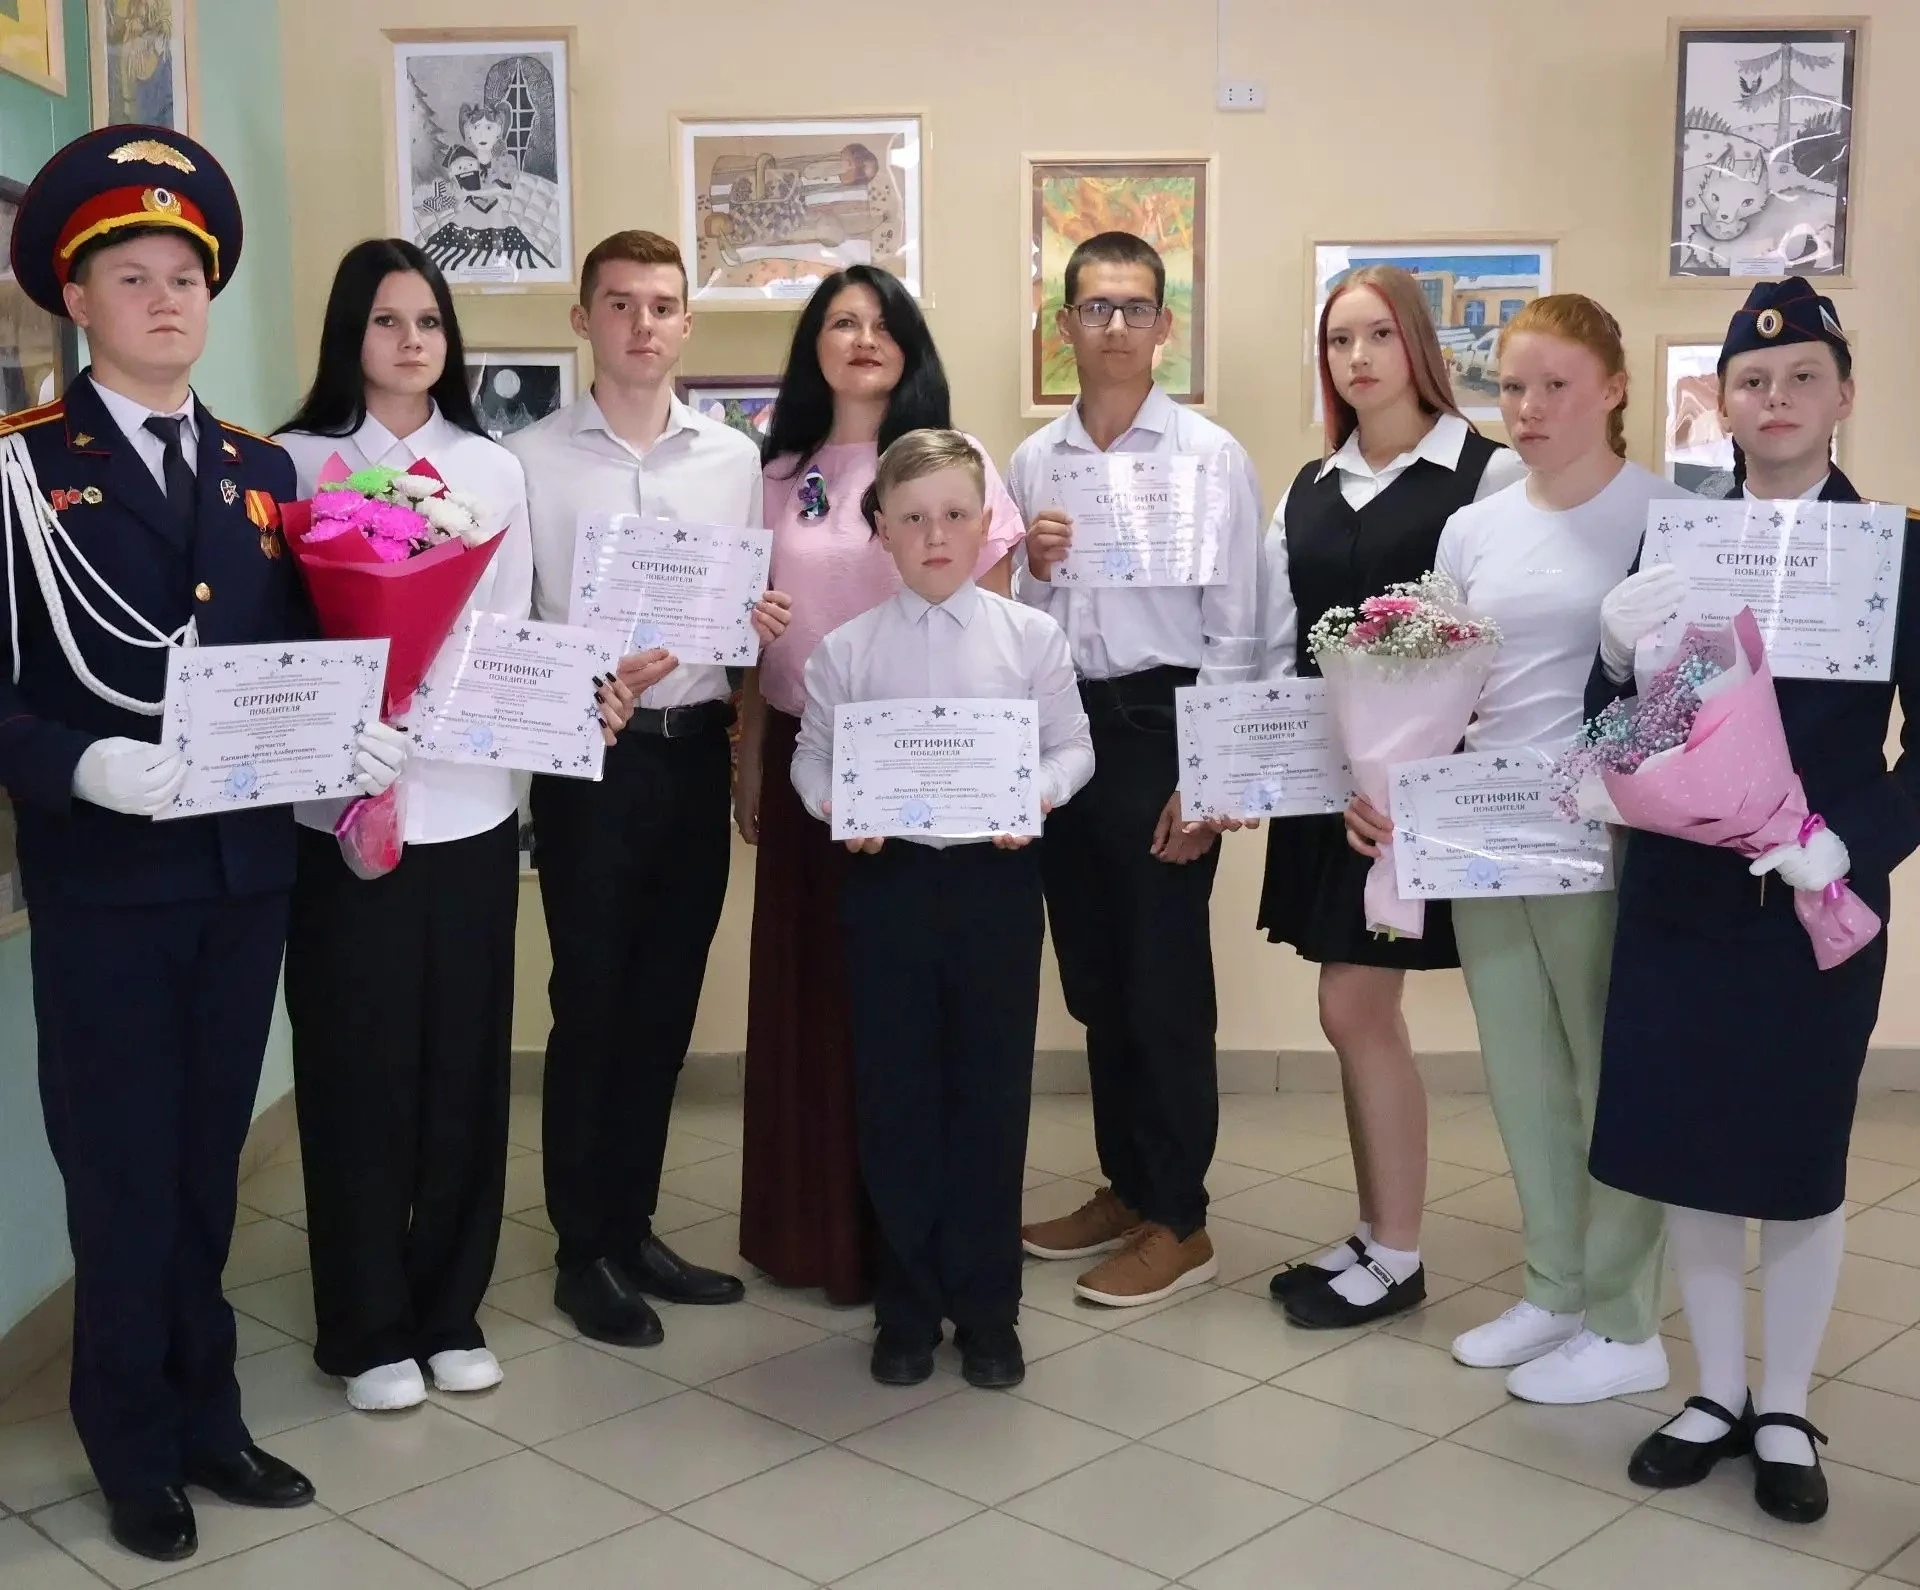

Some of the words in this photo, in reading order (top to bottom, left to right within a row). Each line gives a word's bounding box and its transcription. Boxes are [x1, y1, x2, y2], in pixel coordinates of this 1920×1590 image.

[632, 560, 710, 577] СЕРТИФИКАТ
[473, 659, 554, 679] СЕРТИФИКАТ
[488, 674, 537, 686] ПОБЕДИТЕЛЯ
[233, 690, 319, 708] СЕРТИФИКАТ
[249, 705, 301, 716] ПОБЕДИТЕЛЯ
[1233, 720, 1309, 734] СЕРТИФИКАТ
[894, 738, 976, 749] СЕРТИФИКАТ
[1455, 791, 1541, 805] СЕРТИФИКАТ
[1473, 804, 1526, 813] ПОБЕДИТЕЛЯ
